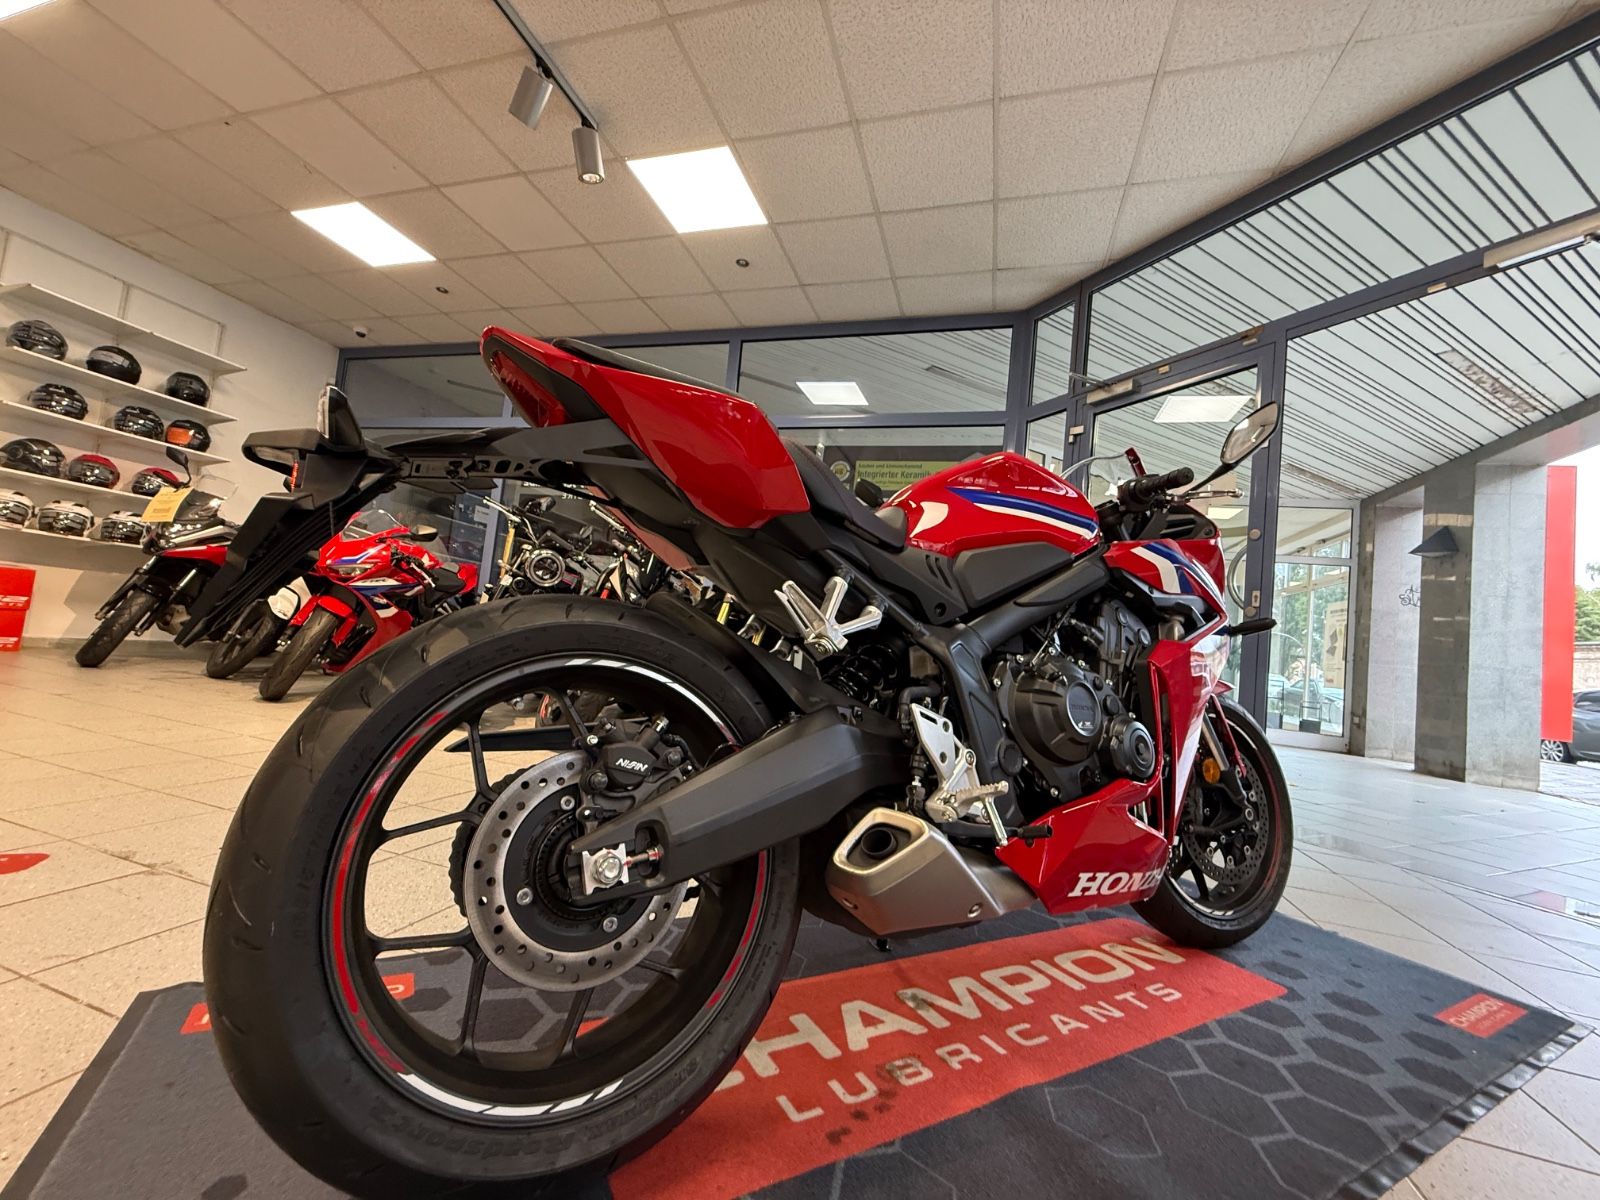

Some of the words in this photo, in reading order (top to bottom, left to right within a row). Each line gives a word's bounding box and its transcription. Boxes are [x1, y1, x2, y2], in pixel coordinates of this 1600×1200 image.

[857, 470, 898, 479] Integrierter
[616, 758, 649, 772] NISSIN
[714, 937, 1186, 1092] HAMPION
[775, 982, 1183, 1123] LUBRICANTS
